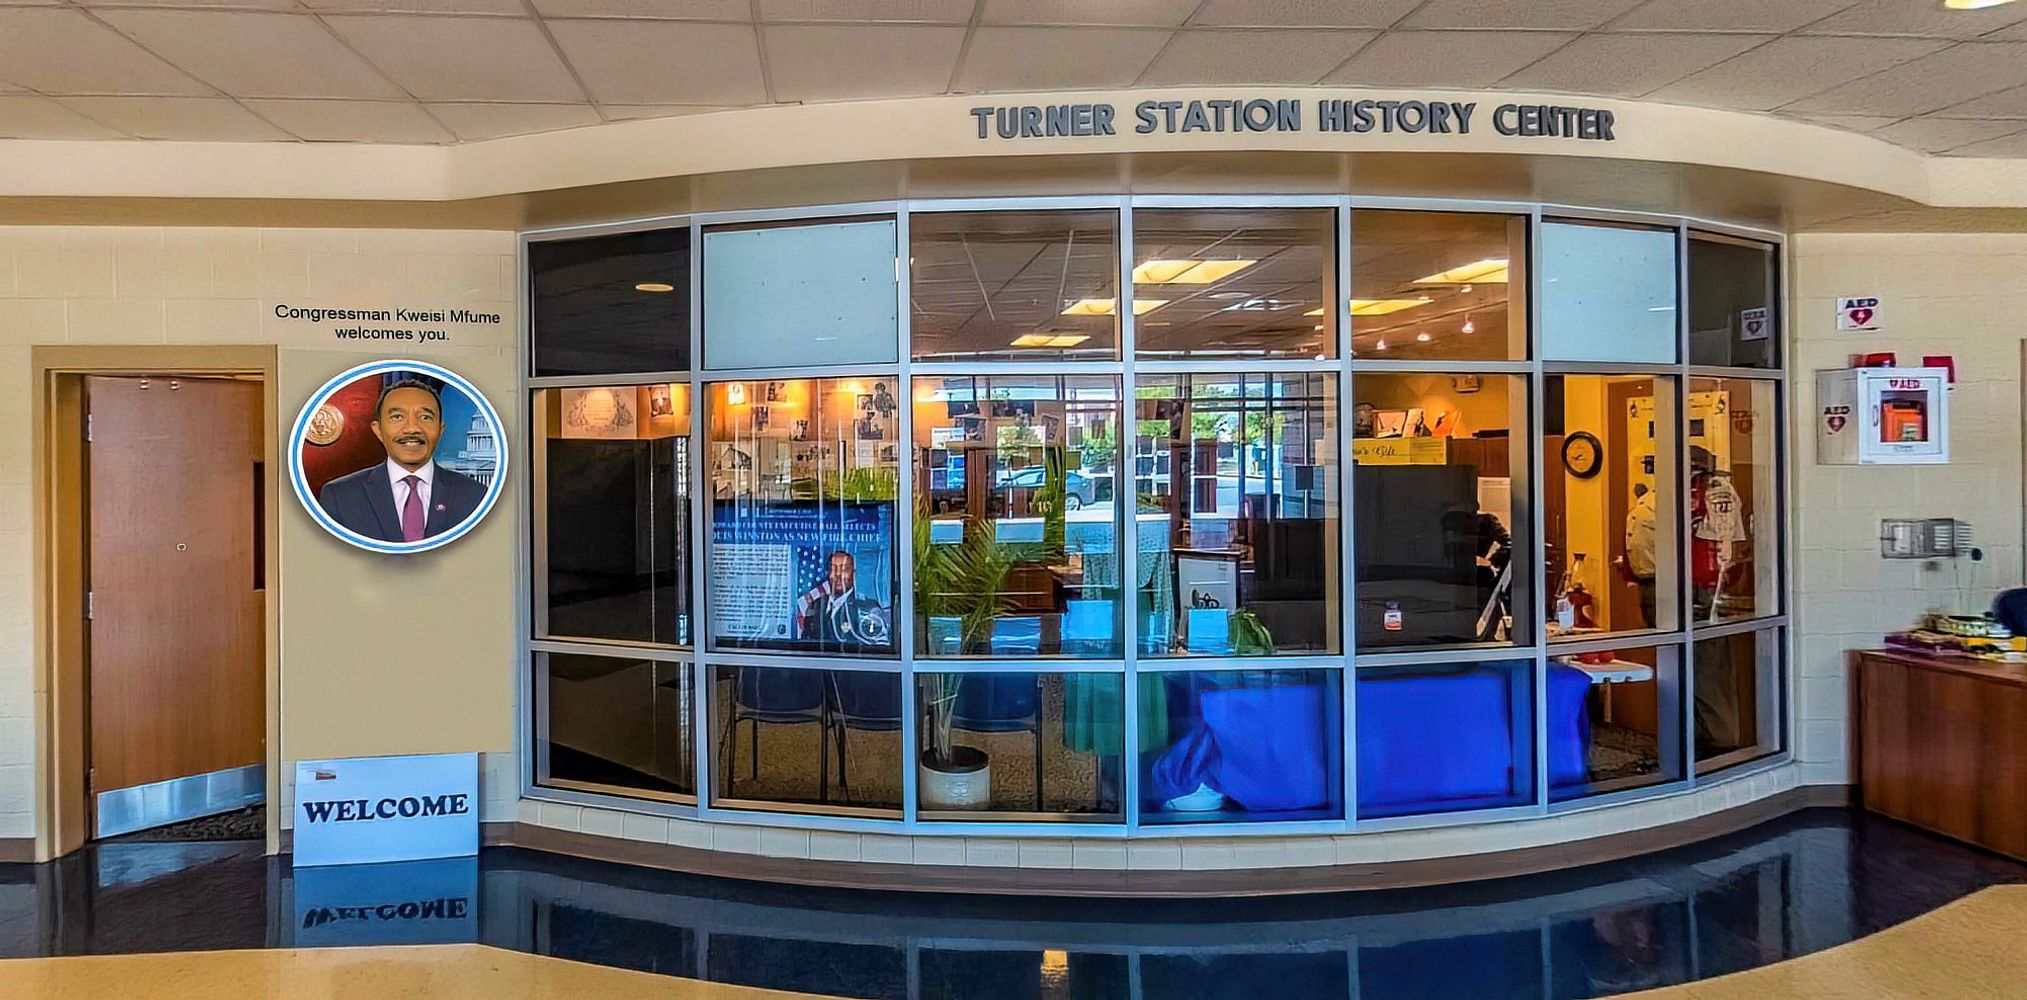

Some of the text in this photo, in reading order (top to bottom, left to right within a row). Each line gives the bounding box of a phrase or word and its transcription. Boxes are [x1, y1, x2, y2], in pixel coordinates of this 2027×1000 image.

[970, 98, 1616, 141] TURNER STATION HISTORY CENTER
[1845, 298, 1879, 309] AED
[1823, 405, 1851, 415] AED
[302, 793, 469, 824] WELCOME
